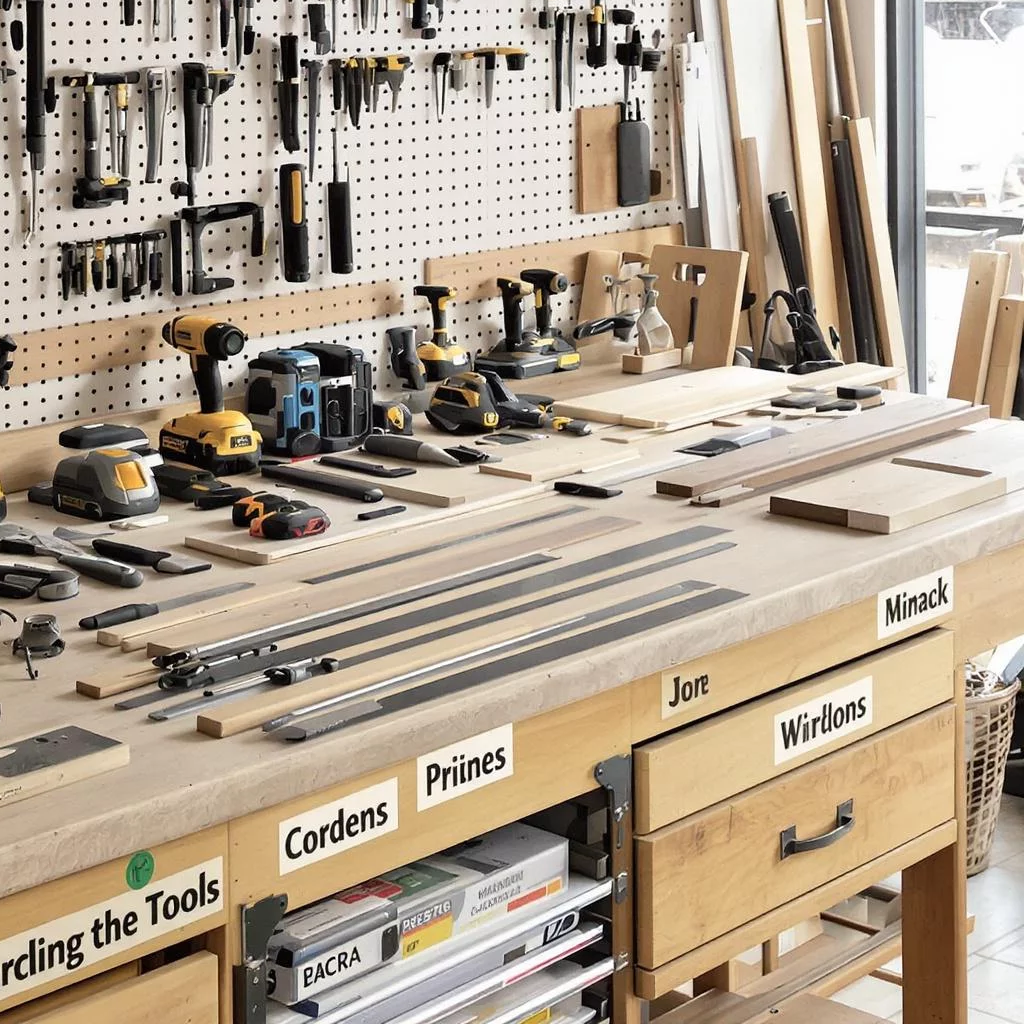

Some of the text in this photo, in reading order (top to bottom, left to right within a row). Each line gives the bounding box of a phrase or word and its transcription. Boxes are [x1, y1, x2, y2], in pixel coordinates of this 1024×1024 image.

[885, 577, 949, 626] Minack
[285, 802, 388, 860] Cordens
[91, 909, 138, 949] the
[145, 872, 220, 926] Tools
